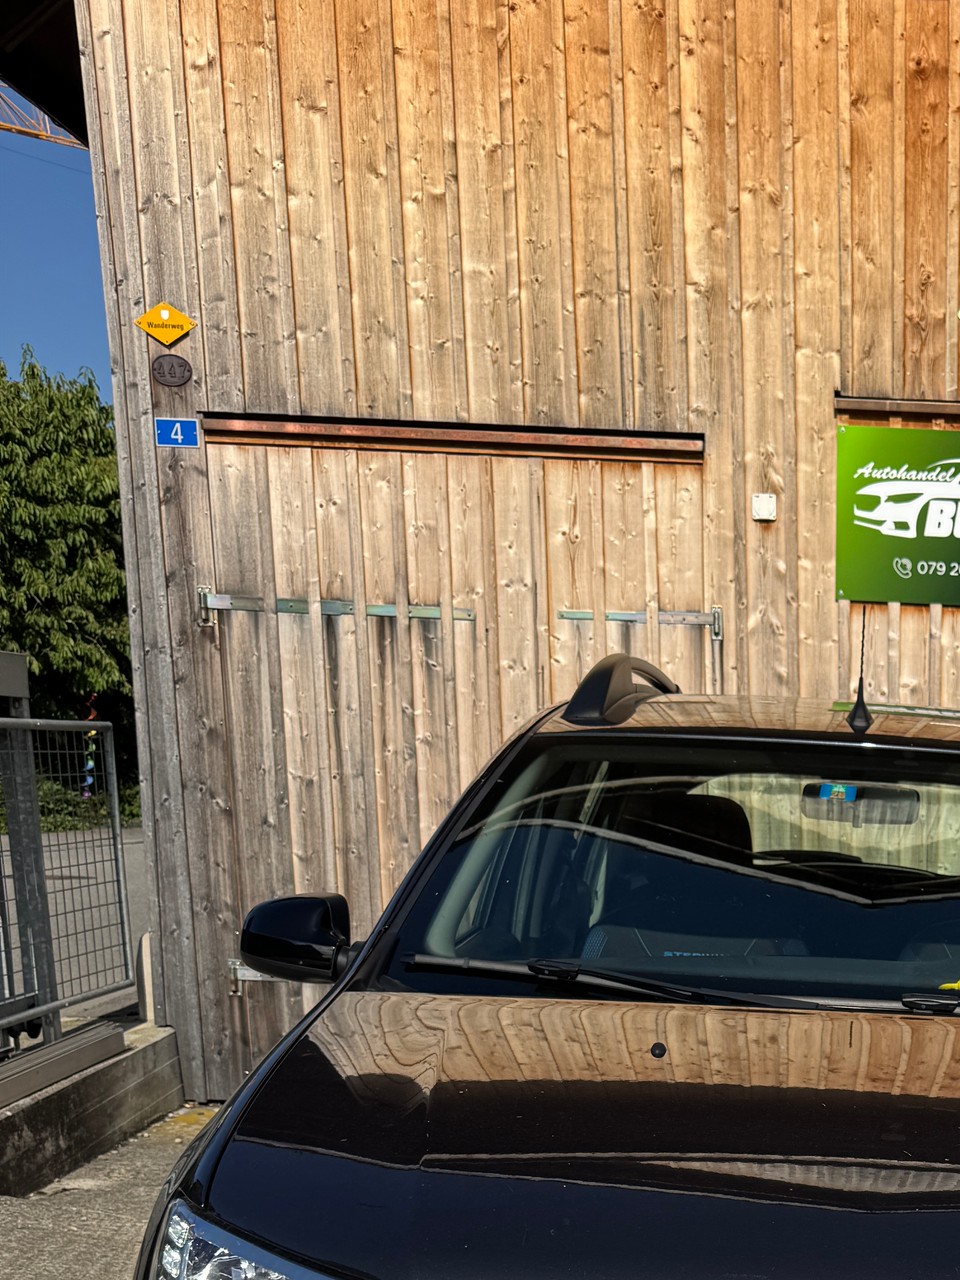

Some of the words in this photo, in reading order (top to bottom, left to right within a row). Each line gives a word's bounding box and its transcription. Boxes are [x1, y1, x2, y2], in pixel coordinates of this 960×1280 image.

[147, 321, 184, 331] Wanderweg
[156, 361, 187, 379] 447
[170, 422, 184, 444] 4
[853, 461, 955, 483] Autohandel
[916, 560, 947, 576] 079
